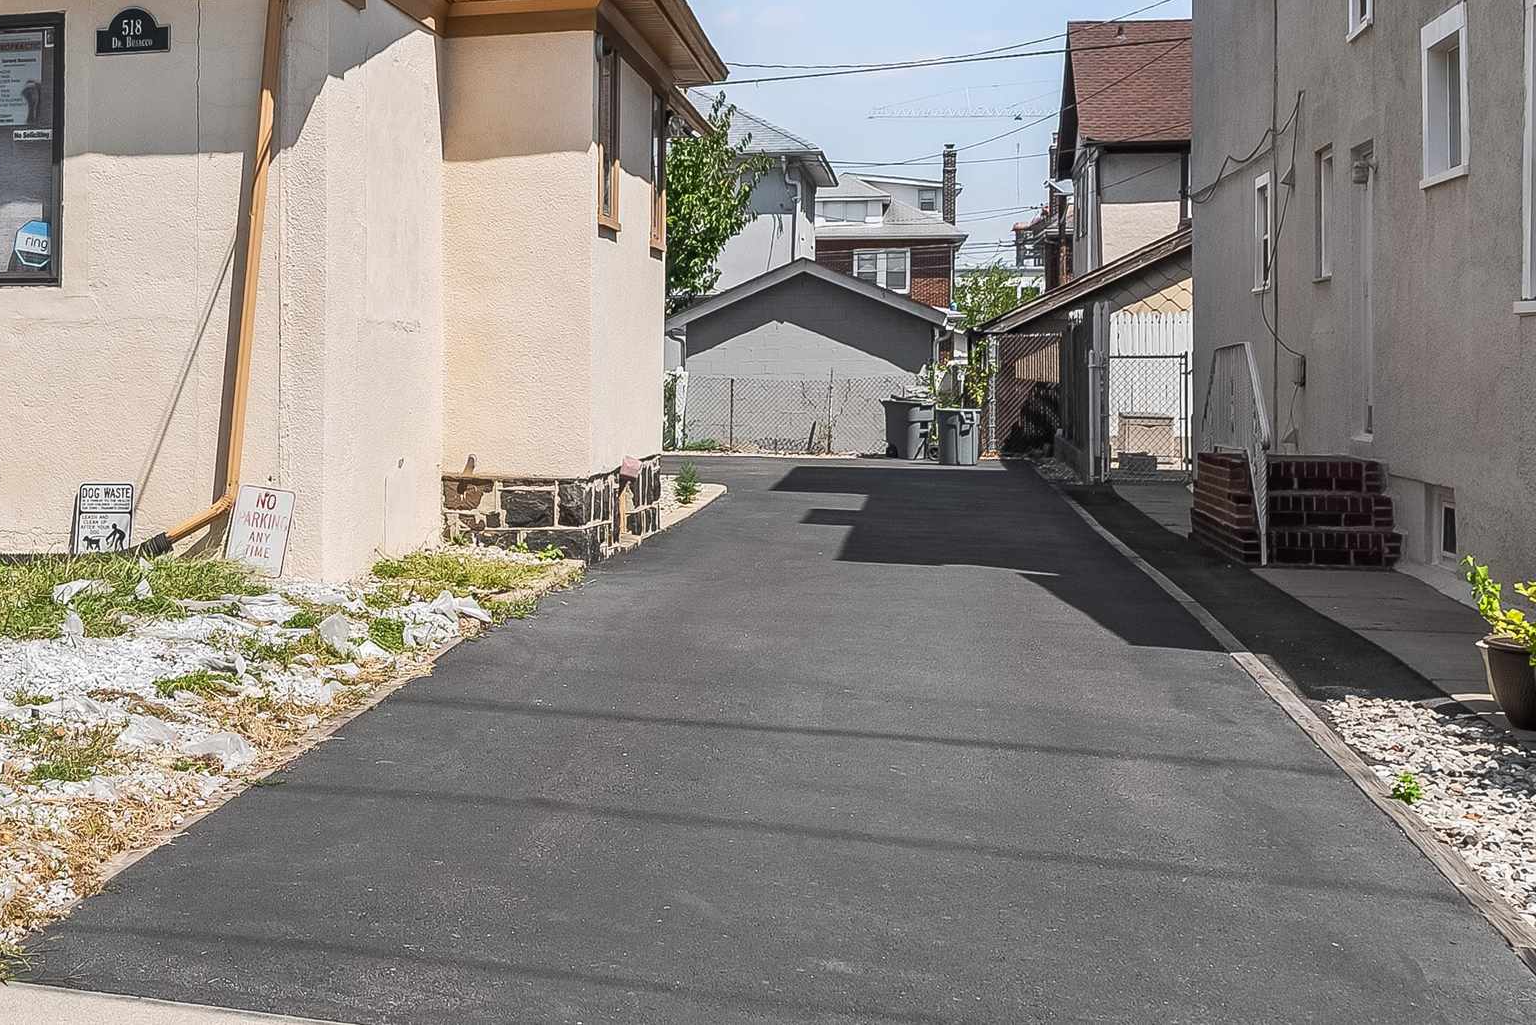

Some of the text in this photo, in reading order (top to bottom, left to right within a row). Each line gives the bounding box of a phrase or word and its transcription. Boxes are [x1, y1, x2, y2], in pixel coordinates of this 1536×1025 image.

[121, 19, 142, 36] 518
[25, 237, 49, 252] ring
[82, 487, 131, 499] DOG WASTE
[256, 492, 277, 510] NO
[248, 531, 271, 543] ANY
[245, 544, 272, 559] TIME
